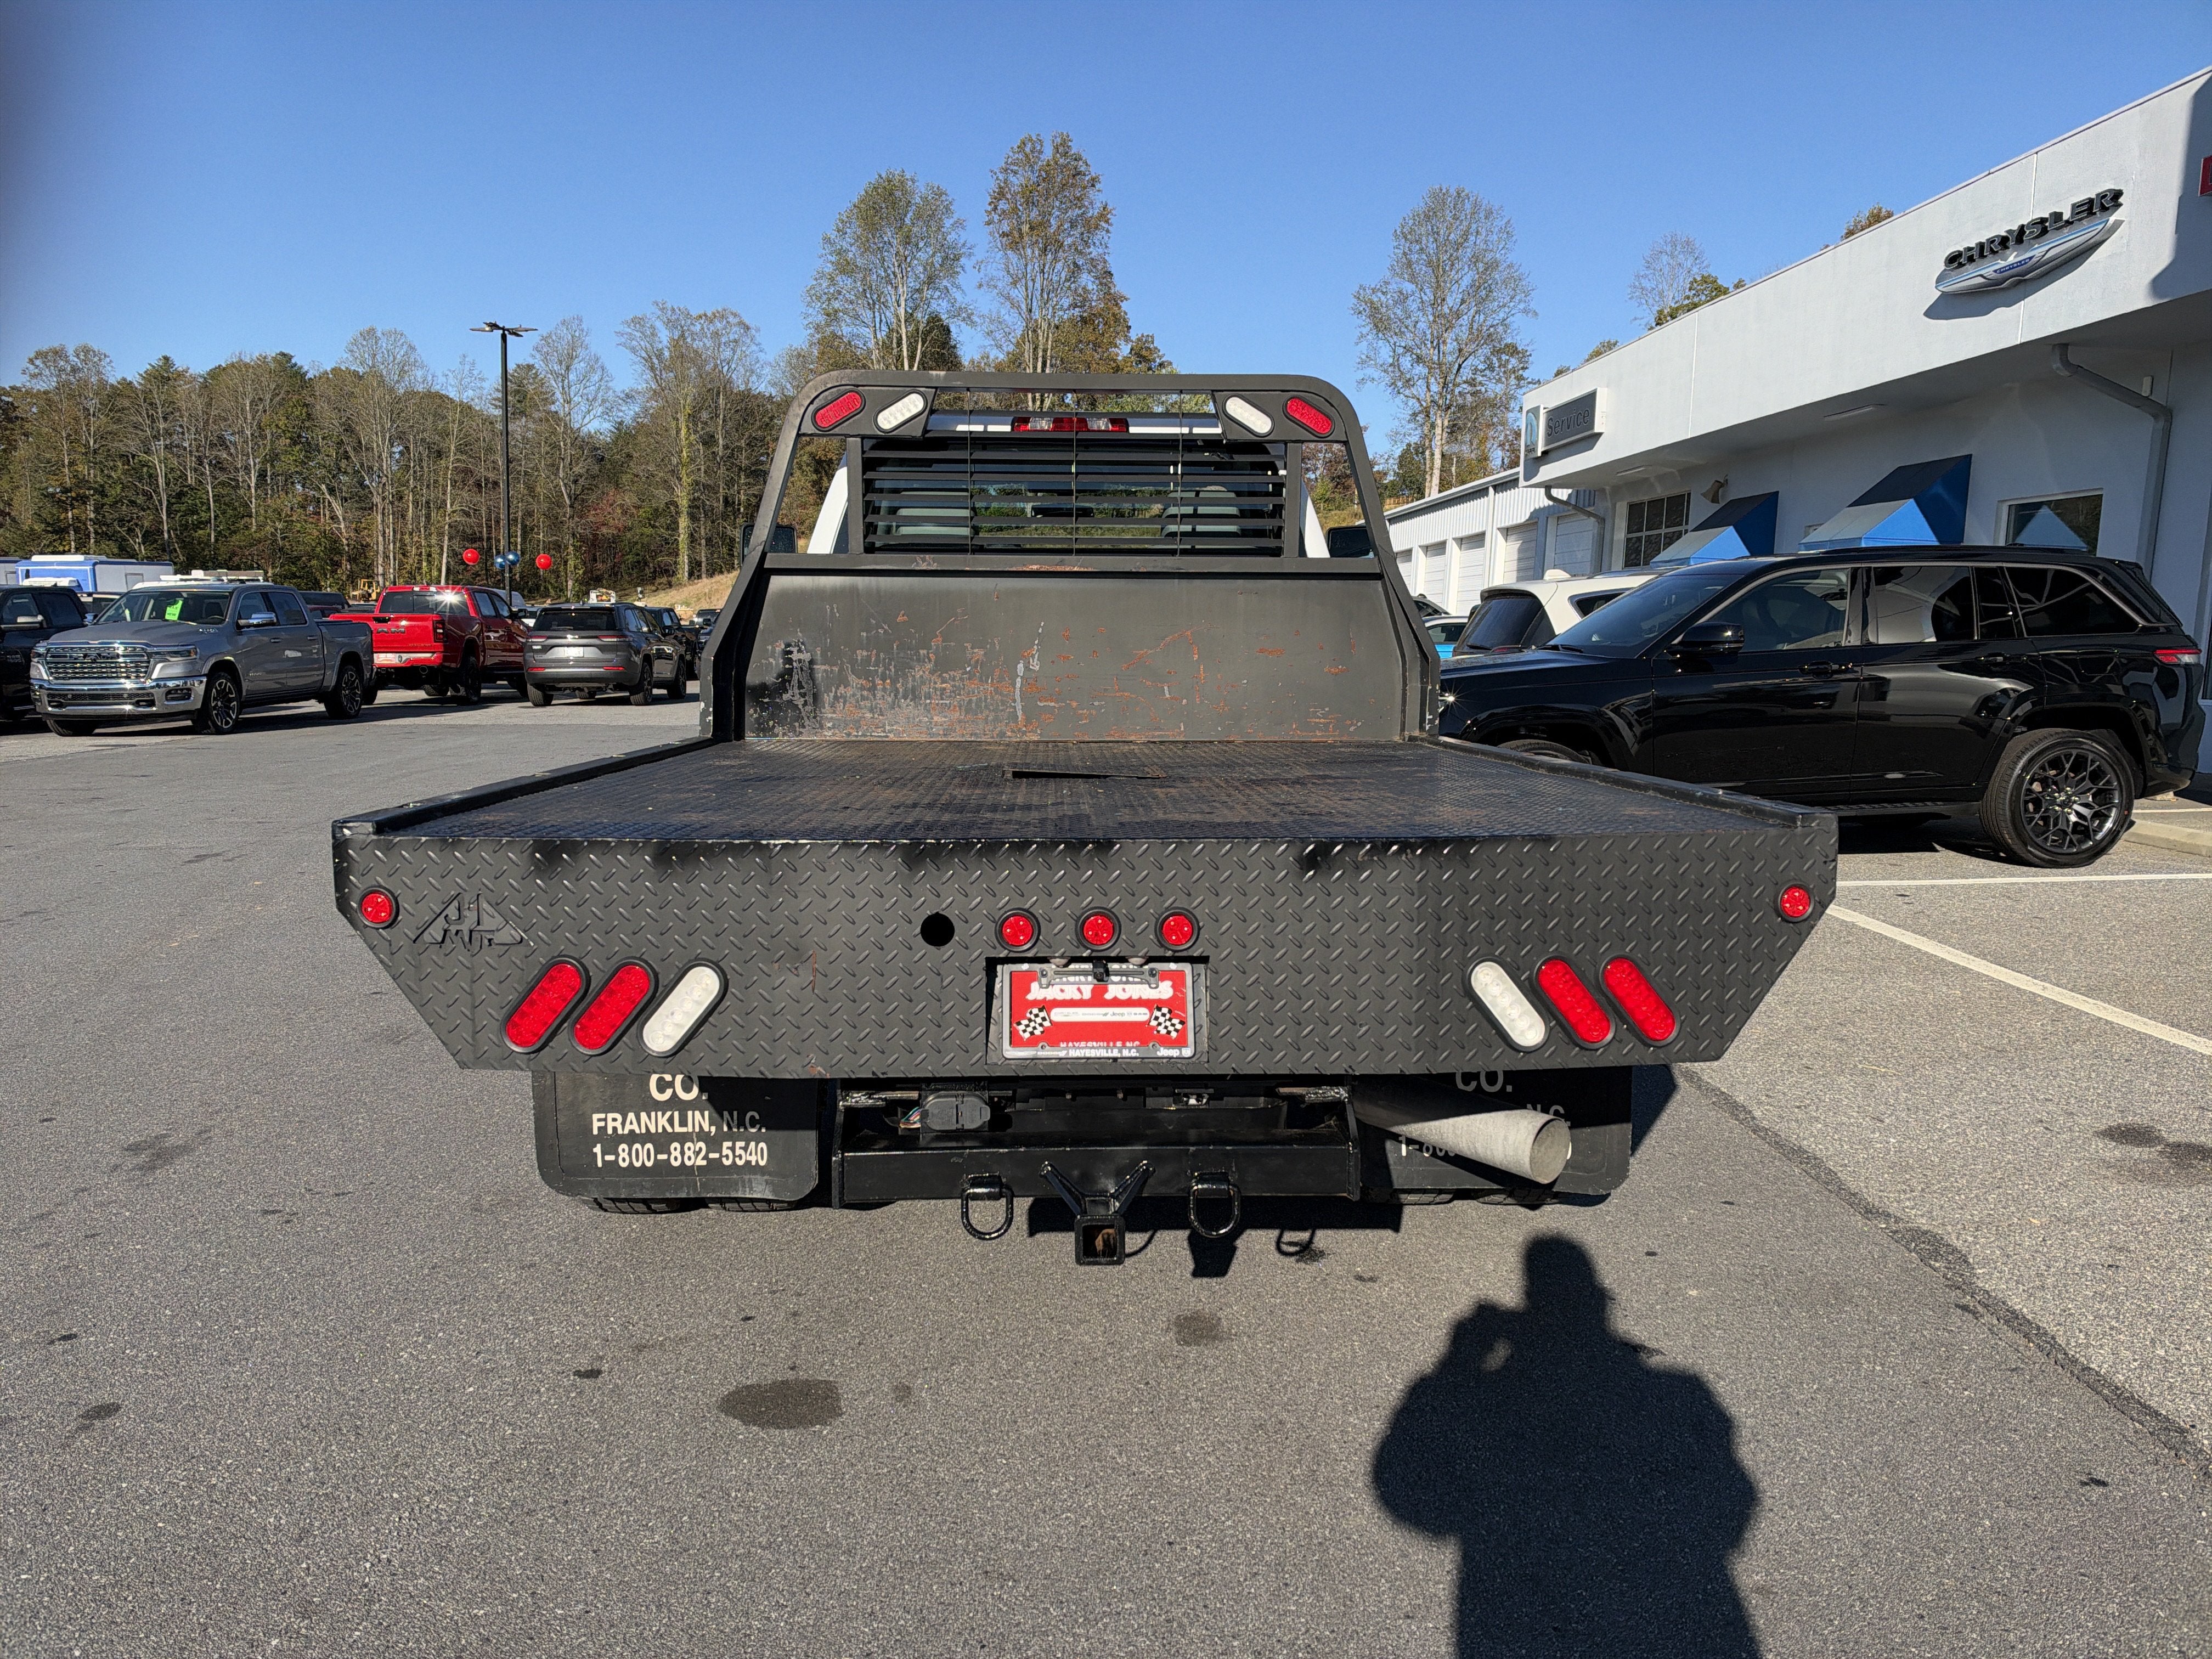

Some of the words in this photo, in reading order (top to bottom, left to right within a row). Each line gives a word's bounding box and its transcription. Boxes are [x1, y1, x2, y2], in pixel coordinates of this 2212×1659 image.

[1944, 189, 2123, 269] CHRYSLER
[1547, 408, 1590, 437] Service
[1025, 980, 1094, 1000] JACKY
[1104, 980, 1174, 1000] JONES
[1069, 1048, 1120, 1057] HAYESVILLE,
[1122, 1048, 1139, 1057] N.C.
[1157, 1047, 1180, 1058] Jeep
[650, 1074, 708, 1101] CO.
[1455, 1070, 1513, 1092] CO.
[592, 1110, 716, 1136] FRANKLIN,
[723, 1111, 766, 1132] N.C.
[592, 1141, 768, 1168] 1-800-882-5540
